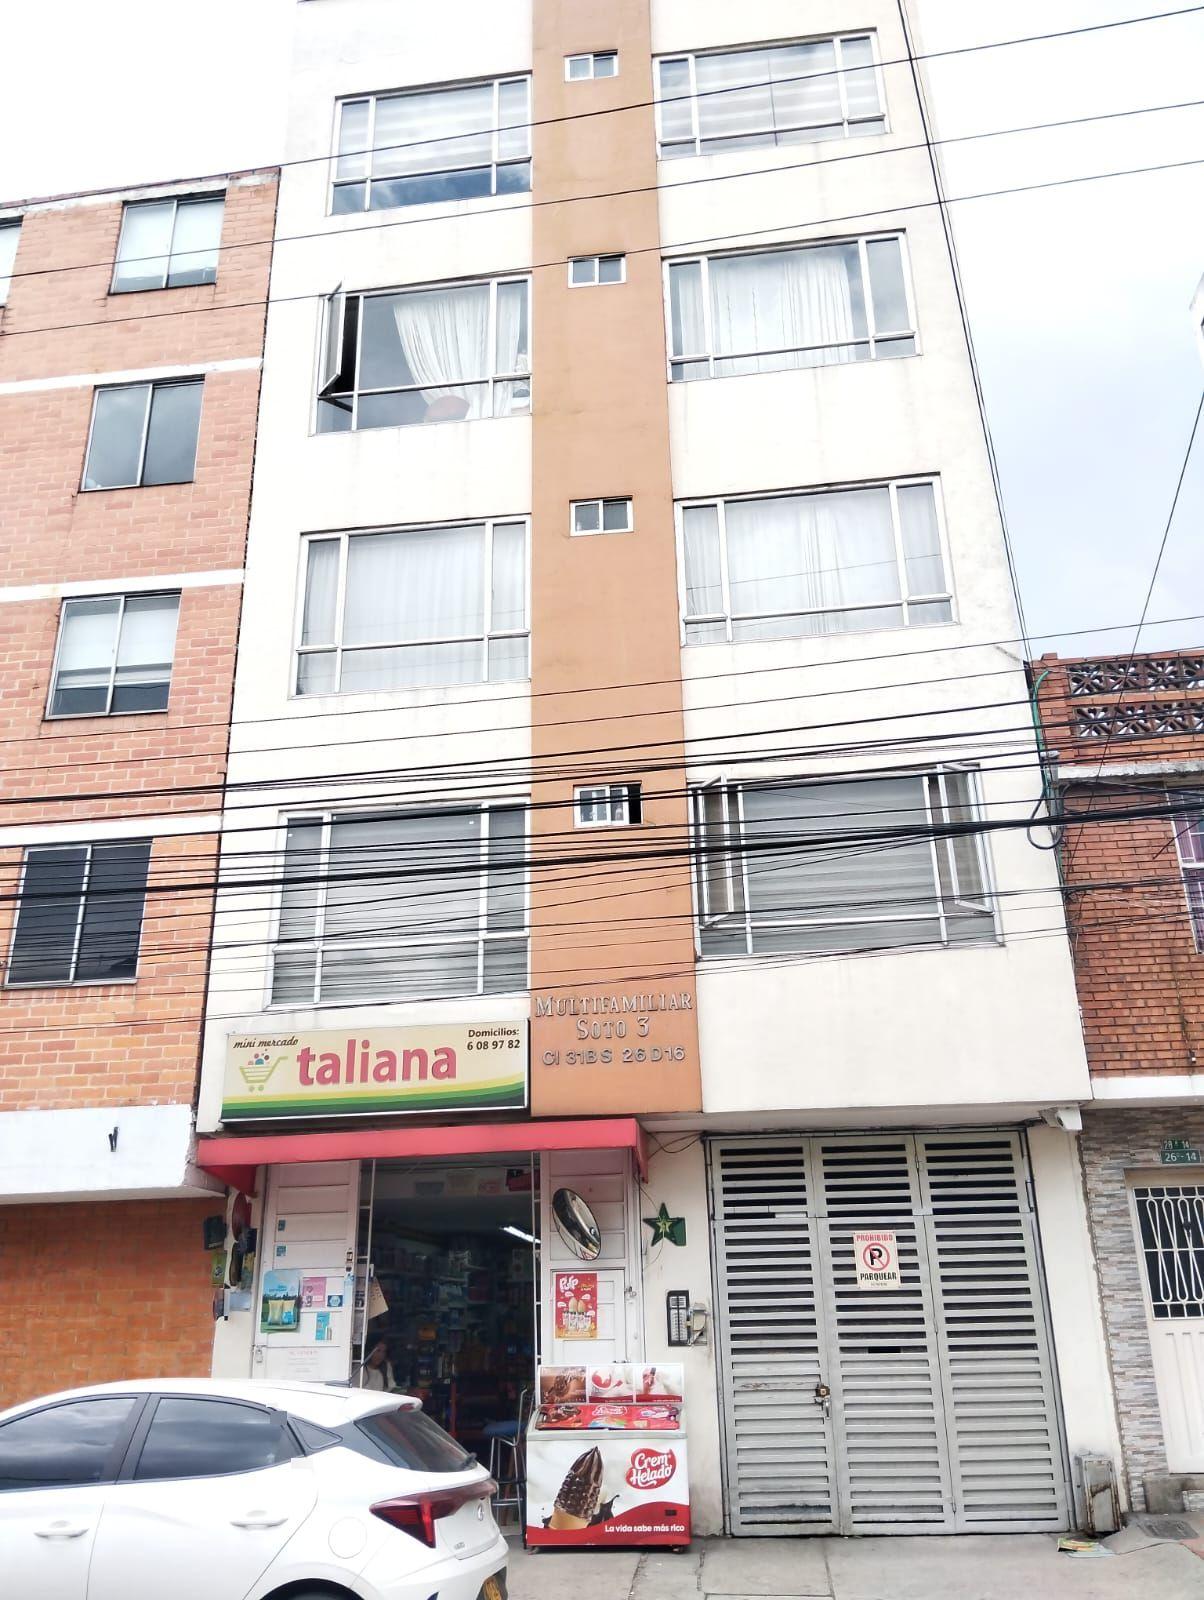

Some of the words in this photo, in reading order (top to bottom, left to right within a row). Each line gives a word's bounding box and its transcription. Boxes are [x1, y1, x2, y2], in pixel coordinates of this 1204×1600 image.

[535, 992, 693, 1017] MULTIFAMILIAR
[468, 1027, 520, 1038] Domicilios:
[576, 1017, 627, 1040] SOTO
[637, 1016, 650, 1038] 3
[233, 1037, 257, 1049] mini
[257, 1035, 299, 1048] mercado
[467, 1041, 474, 1051] 6
[476, 1040, 489, 1050] 08
[491, 1040, 504, 1050] 97
[507, 1039, 520, 1049] 82
[296, 1039, 457, 1086] taliana
[856, 1233, 893, 1242] PROHIBIDO
[860, 1272, 897, 1281] PARQUEAR
[634, 1452, 669, 1470] Crem
[630, 1464, 673, 1487] Helado
[616, 1524, 633, 1532] vida
[633, 1524, 652, 1532] sabe
[653, 1523, 669, 1532] más
[670, 1523, 685, 1532] rico
